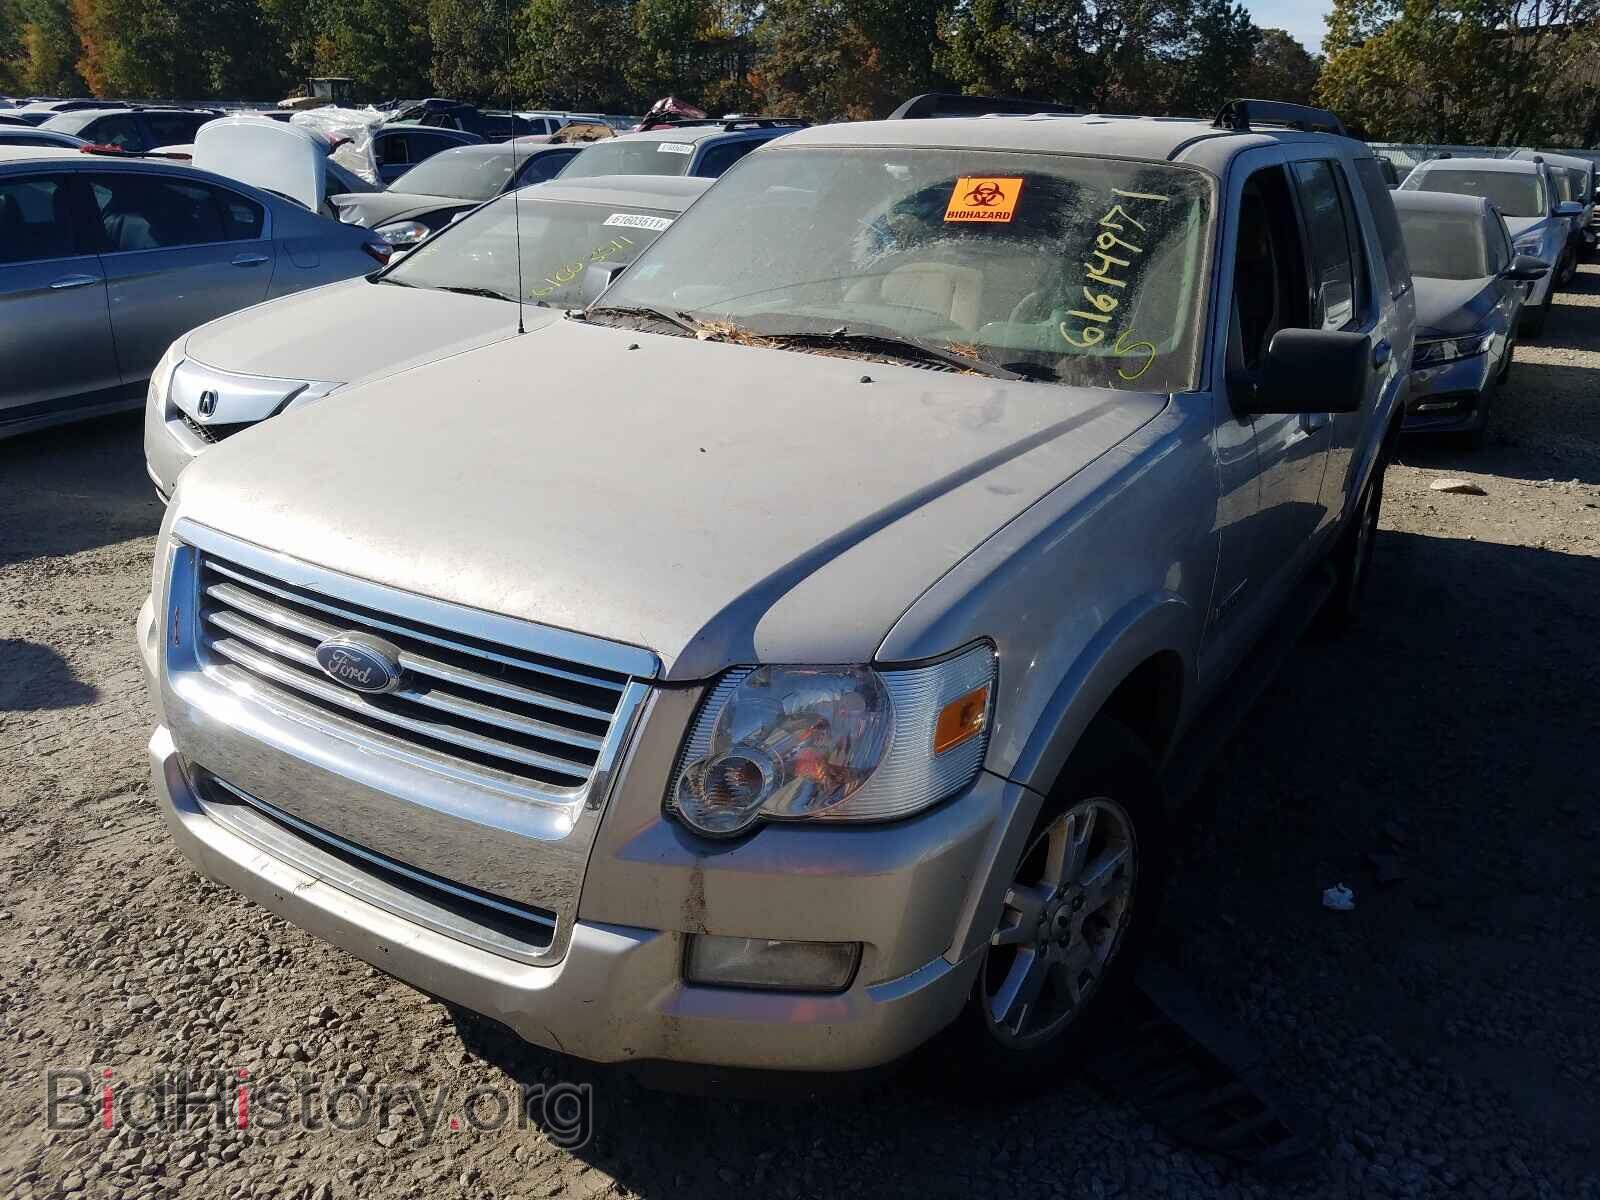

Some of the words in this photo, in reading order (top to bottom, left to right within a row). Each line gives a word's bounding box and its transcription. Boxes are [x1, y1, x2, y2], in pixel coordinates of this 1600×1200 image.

[946, 210, 1011, 220] BIOHAZARD
[1060, 187, 1170, 348] 61614971
[328, 649, 372, 684] Ford
